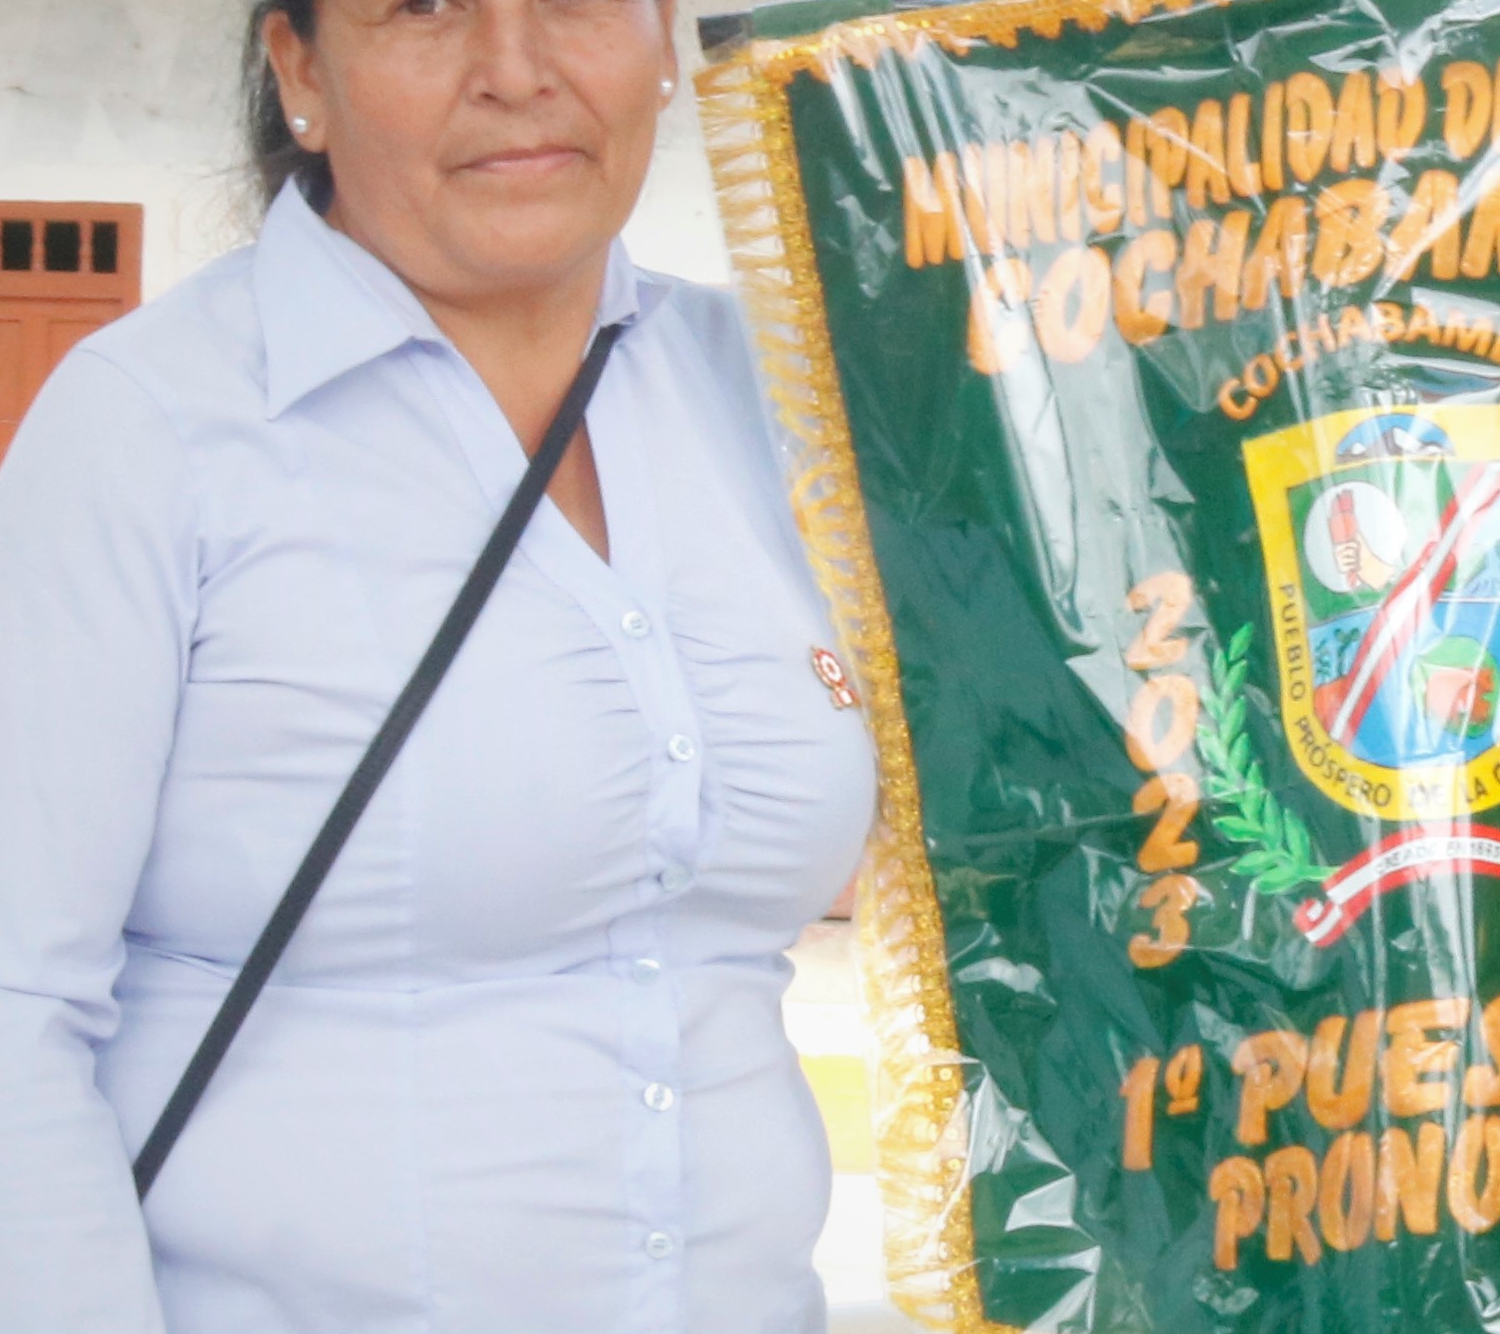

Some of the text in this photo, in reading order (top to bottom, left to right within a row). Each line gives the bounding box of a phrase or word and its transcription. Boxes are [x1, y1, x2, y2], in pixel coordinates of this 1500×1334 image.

[903, 71, 1426, 268] MUNICIPALIDAD
[1125, 570, 1200, 970] 2023
[1279, 582, 1307, 703] PUEBLO
[1464, 783, 1489, 804] LA
